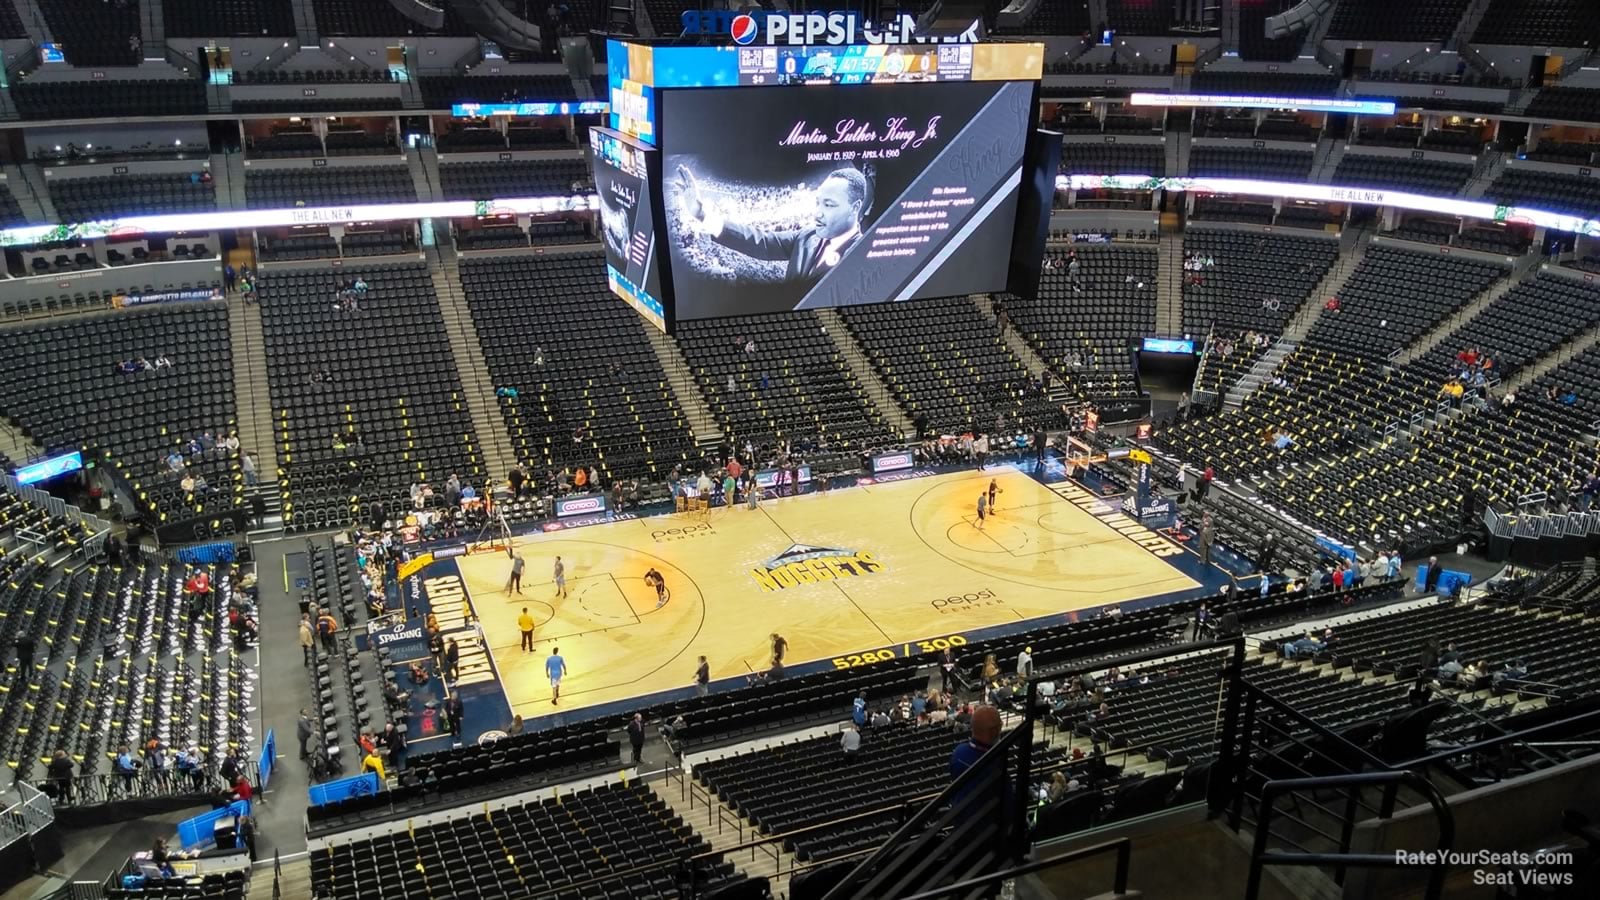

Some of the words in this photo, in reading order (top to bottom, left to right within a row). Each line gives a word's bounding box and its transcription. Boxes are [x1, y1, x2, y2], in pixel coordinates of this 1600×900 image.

[766, 14, 855, 45] PEPSI
[863, 14, 979, 44] CENR
[785, 57, 796, 73] 0
[920, 55, 930, 71] 0
[779, 120, 828, 146] Martin
[830, 118, 876, 144] Luther
[879, 116, 916, 149] King
[807, 151, 833, 162] JANUARY
[862, 150, 877, 159] APRIL
[1331, 189, 1345, 199] THE
[1347, 190, 1362, 200] ALL
[1364, 191, 1385, 202] NEW
[292, 211, 309, 221] THE
[313, 210, 328, 220] ALL
[331, 209, 353, 219] NEW
[901, 211, 937, 221] established
[875, 225, 909, 235] reputation
[872, 238, 900, 247] greatest
[881, 457, 906, 467] conoco
[565, 499, 596, 512] conoco
[1141, 503, 1170, 516] SPALDING
[651, 521, 713, 540] pepsi
[1096, 511, 1185, 557] NUGGETS
[749, 550, 887, 593] NUGGETS
[409, 574, 421, 600] xfinity
[931, 588, 996, 610] pepsi
[378, 627, 422, 645] SPALDING
[832, 648, 896, 670] 5280
[916, 635, 967, 653] 300
